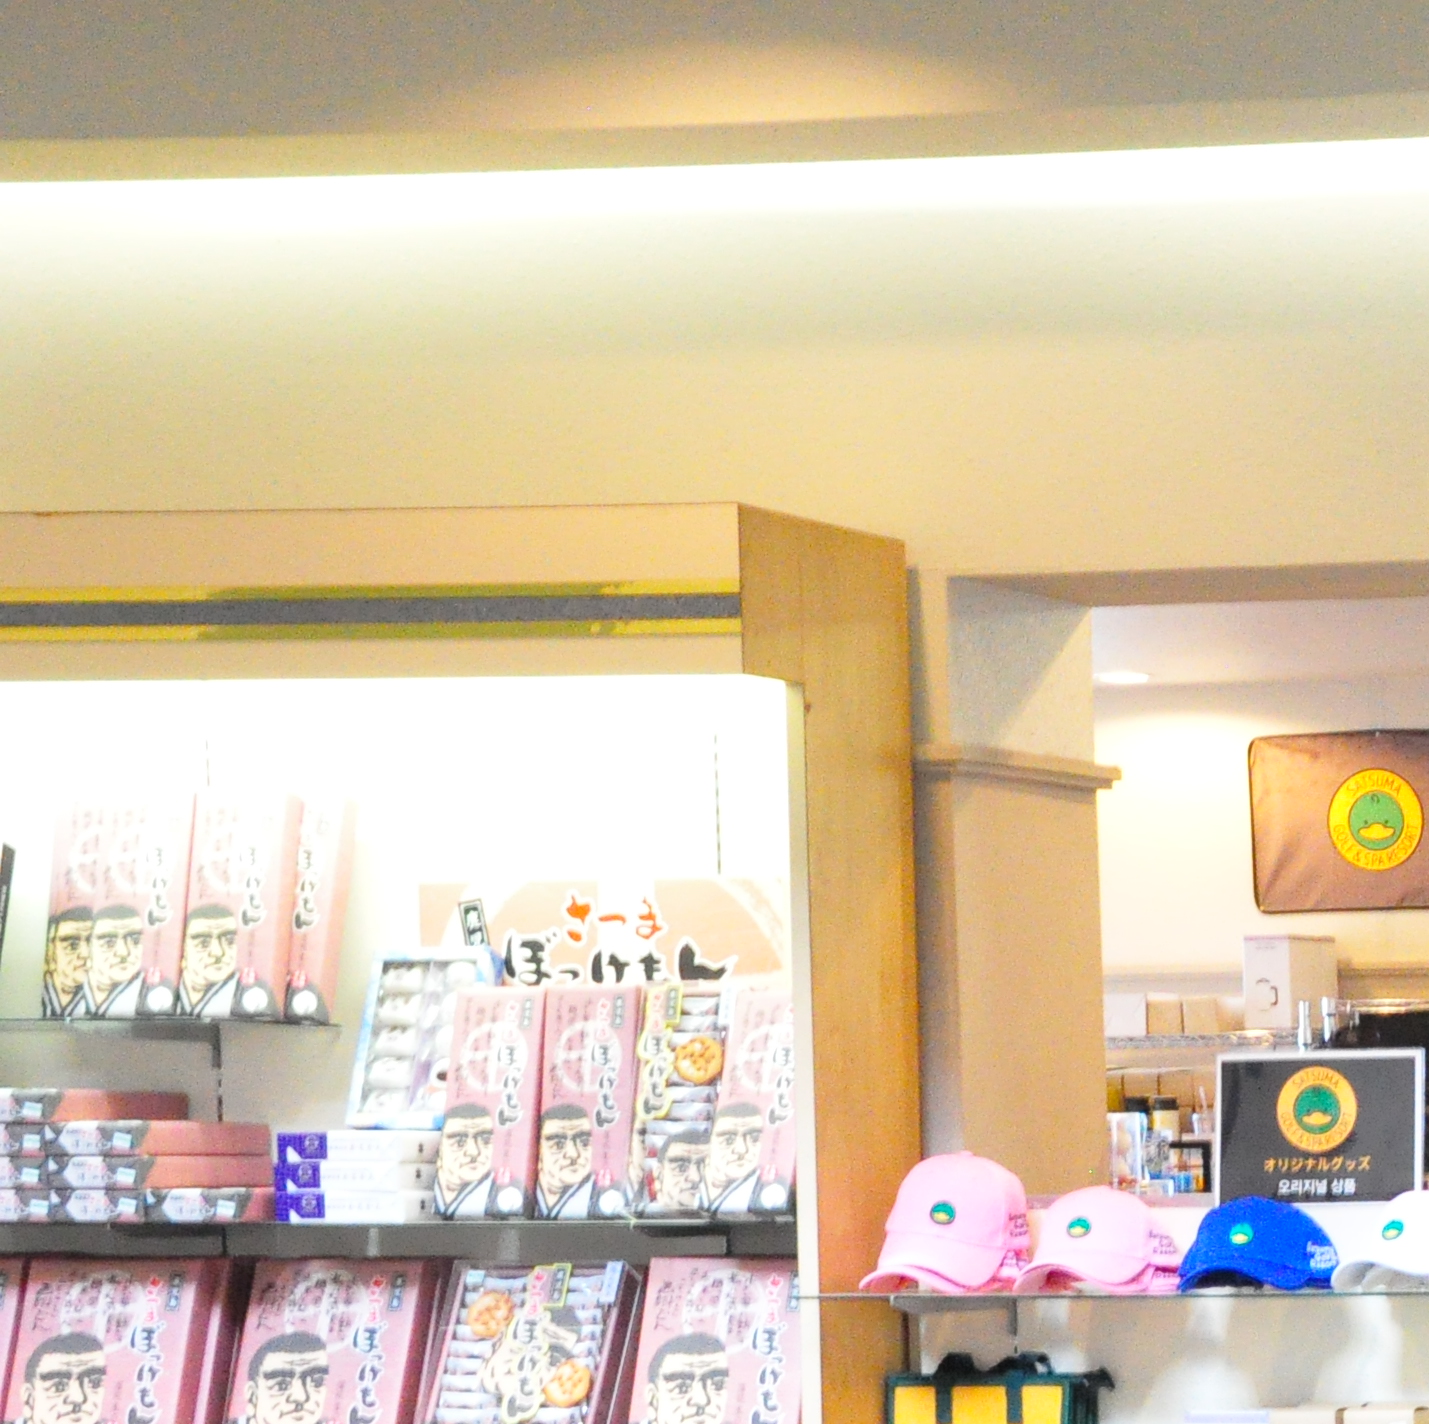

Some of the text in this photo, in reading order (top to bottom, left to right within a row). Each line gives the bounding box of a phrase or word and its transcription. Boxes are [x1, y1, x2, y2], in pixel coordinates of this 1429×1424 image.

[1346, 773, 1402, 797] SATSUMA
[1263, 1155, 1371, 1175] オリジナルグッズ
[505, 1315, 541, 1420] ぼっけもん
